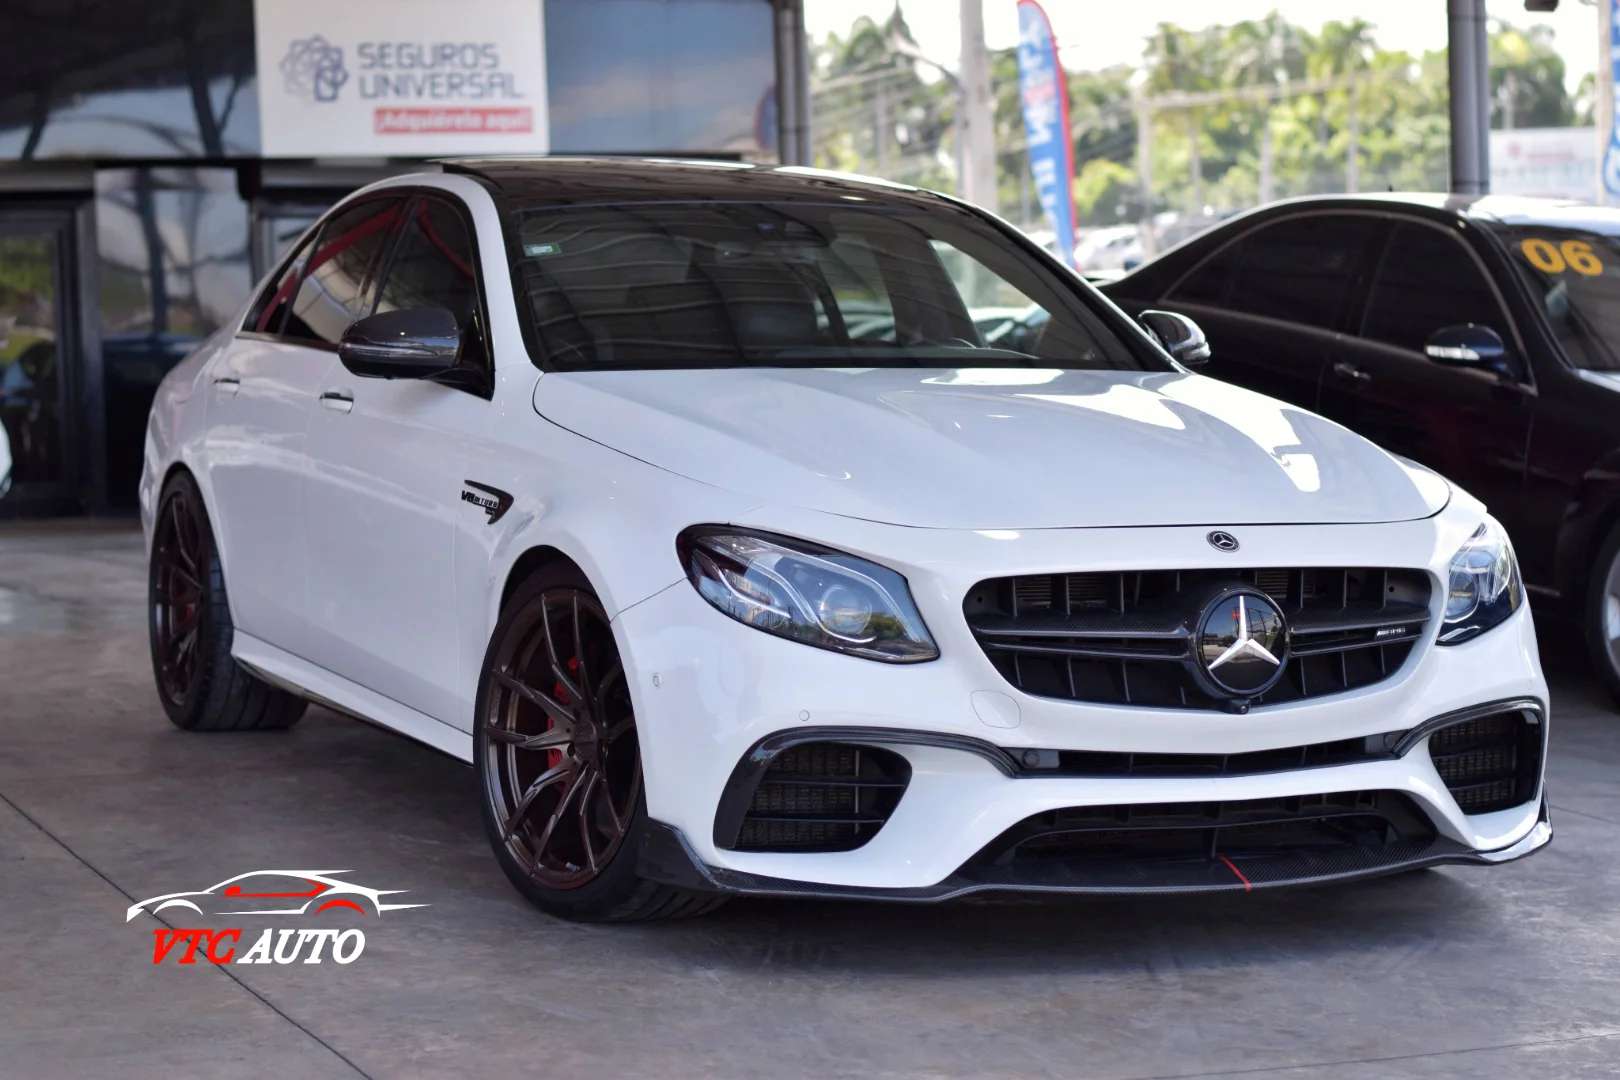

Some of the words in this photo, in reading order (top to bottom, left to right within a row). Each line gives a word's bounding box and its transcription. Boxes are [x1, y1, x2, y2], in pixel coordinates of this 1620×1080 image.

[357, 42, 500, 70] SEGUROS
[358, 72, 526, 99] UNIVERSAL
[1520, 238, 1603, 276] 06
